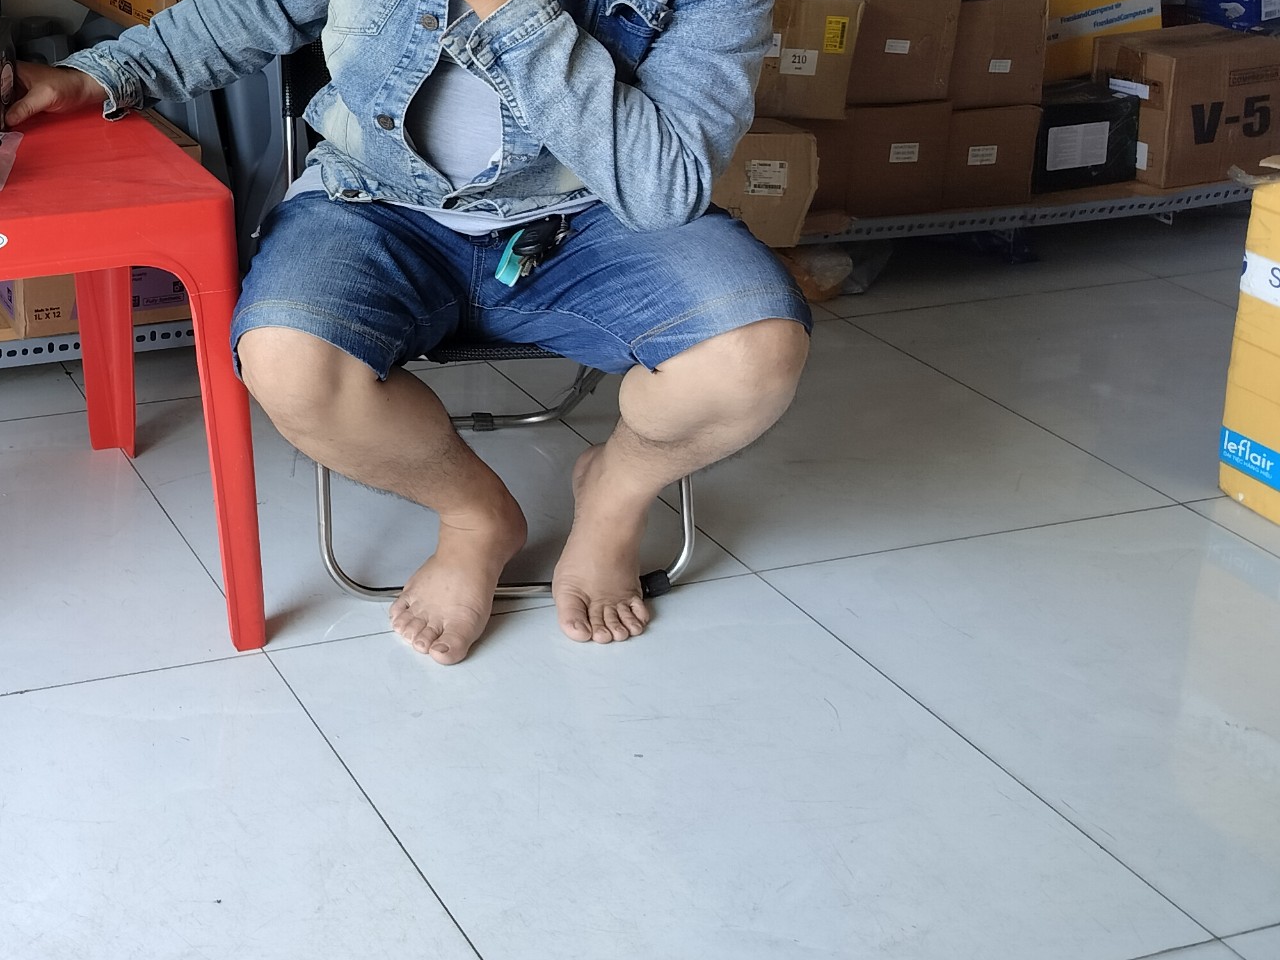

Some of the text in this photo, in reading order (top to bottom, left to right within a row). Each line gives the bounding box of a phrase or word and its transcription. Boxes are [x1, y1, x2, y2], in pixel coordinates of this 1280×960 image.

[1093, 10, 1147, 28] FrieslandCampina
[791, 54, 807, 64] 210
[1191, 94, 1271, 145] V-5
[33, 311, 62, 321] 1L X 12
[1223, 430, 1274, 471] leflair
